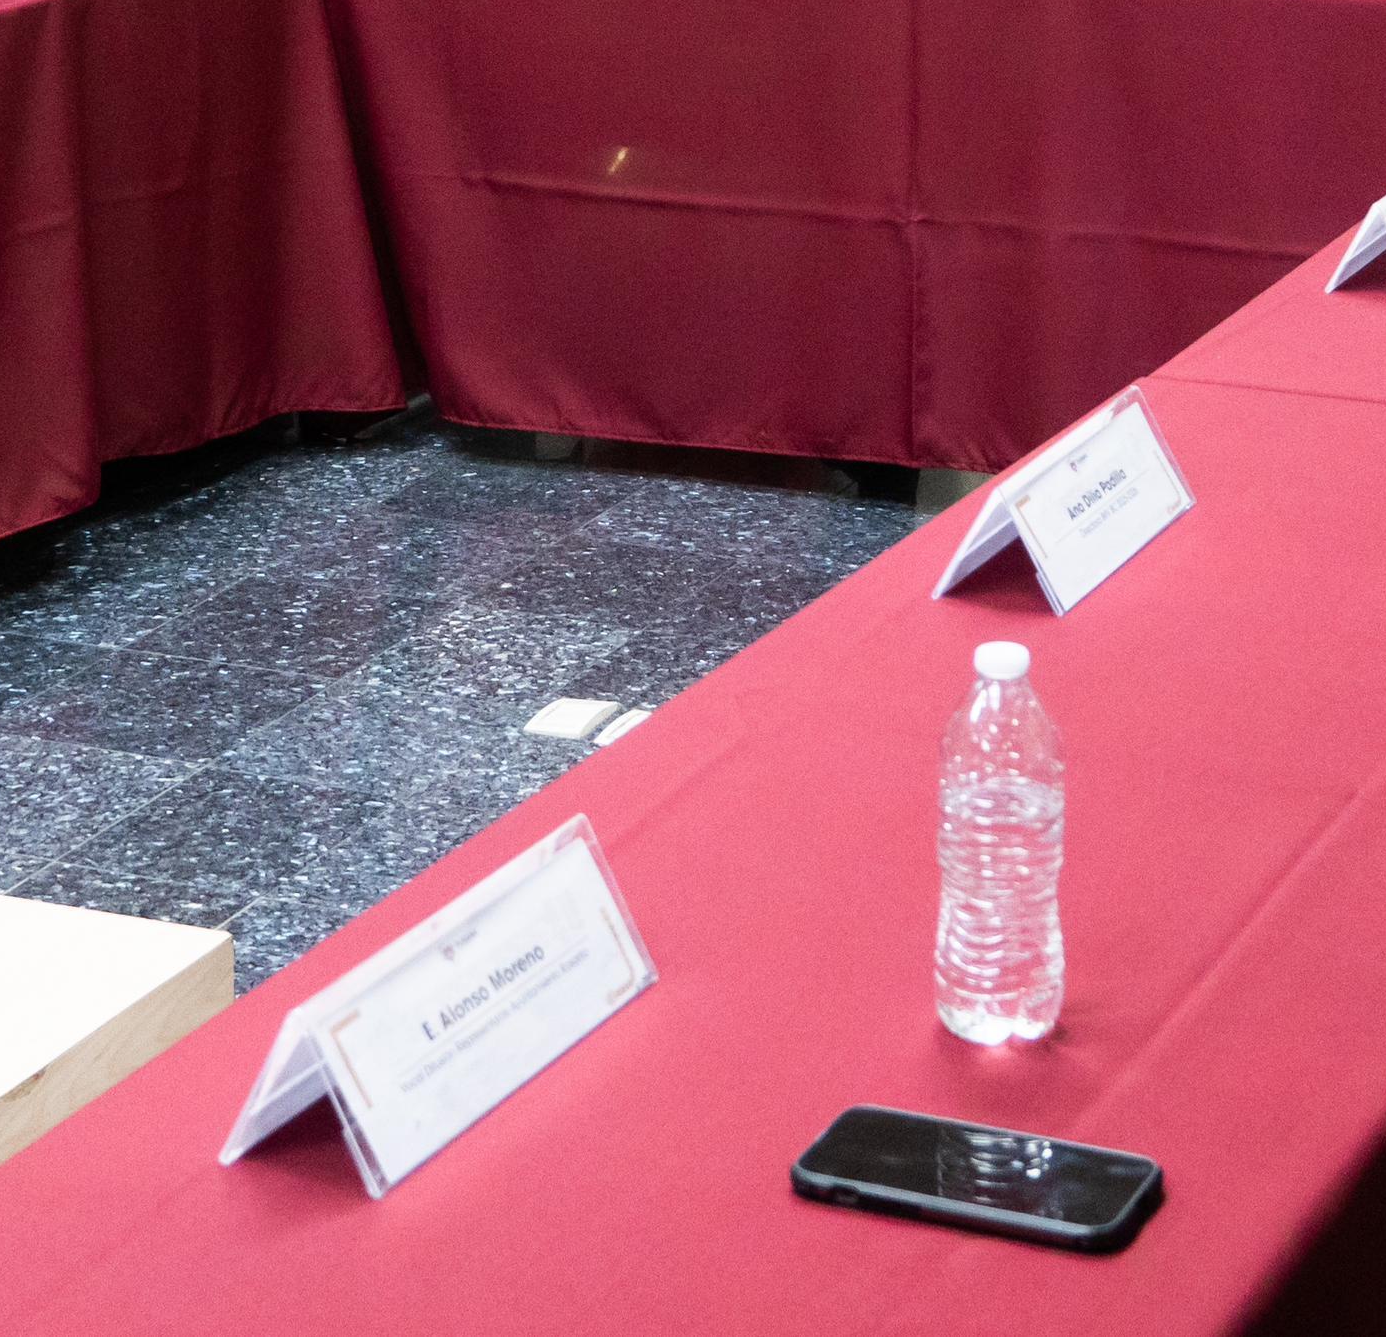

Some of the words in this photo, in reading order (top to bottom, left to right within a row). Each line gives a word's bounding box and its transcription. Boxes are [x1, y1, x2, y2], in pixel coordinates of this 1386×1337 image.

[1067, 502, 1086, 521] Ana
[439, 986, 490, 1030] Alonso
[488, 945, 546, 991] Moreno
